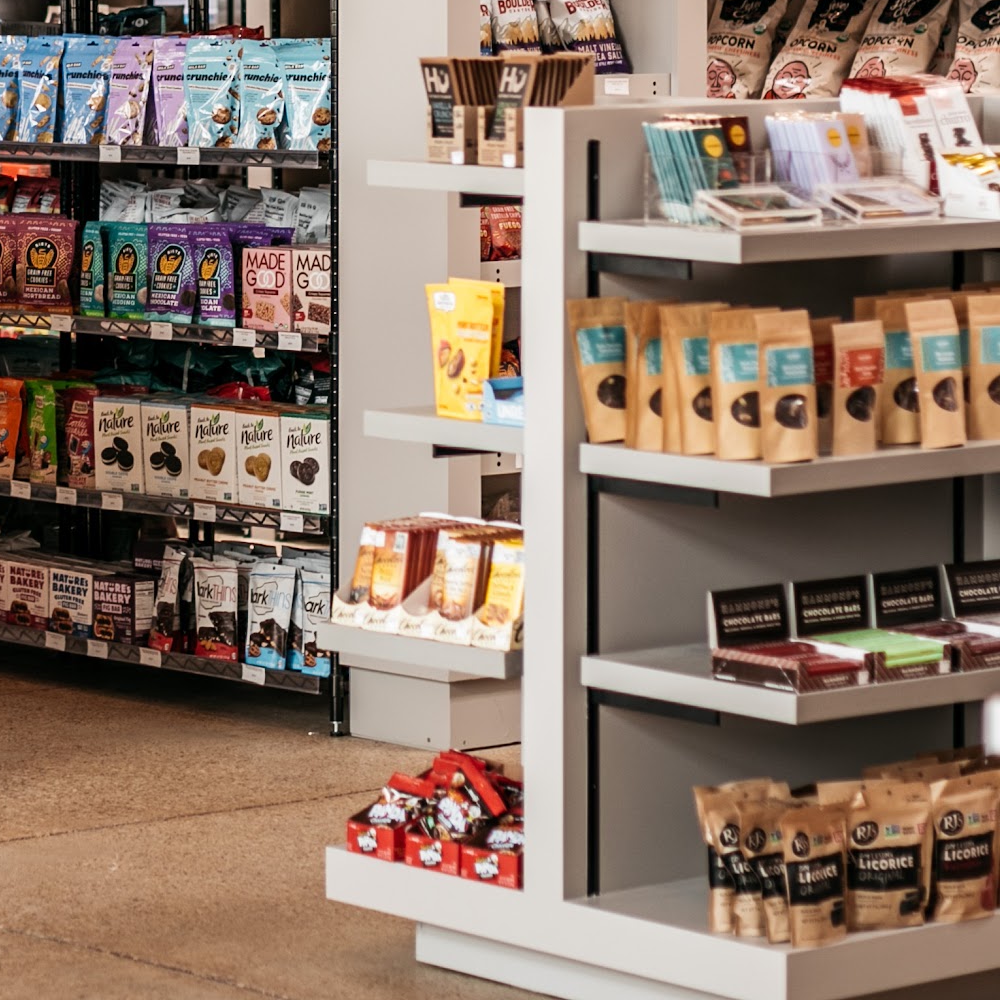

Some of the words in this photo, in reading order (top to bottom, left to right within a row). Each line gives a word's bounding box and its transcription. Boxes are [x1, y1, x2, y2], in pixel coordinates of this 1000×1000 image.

[246, 252, 286, 271] MADE
[296, 254, 331, 271] MAD
[246, 270, 286, 289] GOOD
[296, 272, 331, 289] GOO
[98, 416, 134, 433] nature
[146, 420, 181, 437] nature
[195, 422, 229, 439] nature
[241, 428, 273, 445] nature
[286, 432, 321, 449] nature
[9, 576, 45, 590] BAKERY
[52, 582, 89, 597] BAKERY
[959, 585, 996, 598] CHOCOLATE
[93, 590, 131, 605] BAKERY
[882, 596, 918, 608] CHOCOLATE
[917, 594, 935, 605] BARS
[803, 604, 843, 618] CHOCOLATE
[843, 603, 861, 614] BARS
[723, 613, 763, 628] CHOCOLATE
[762, 611, 781, 623] BARS
[944, 843, 989, 862] LICORICE
[858, 855, 914, 870] LICORICE
